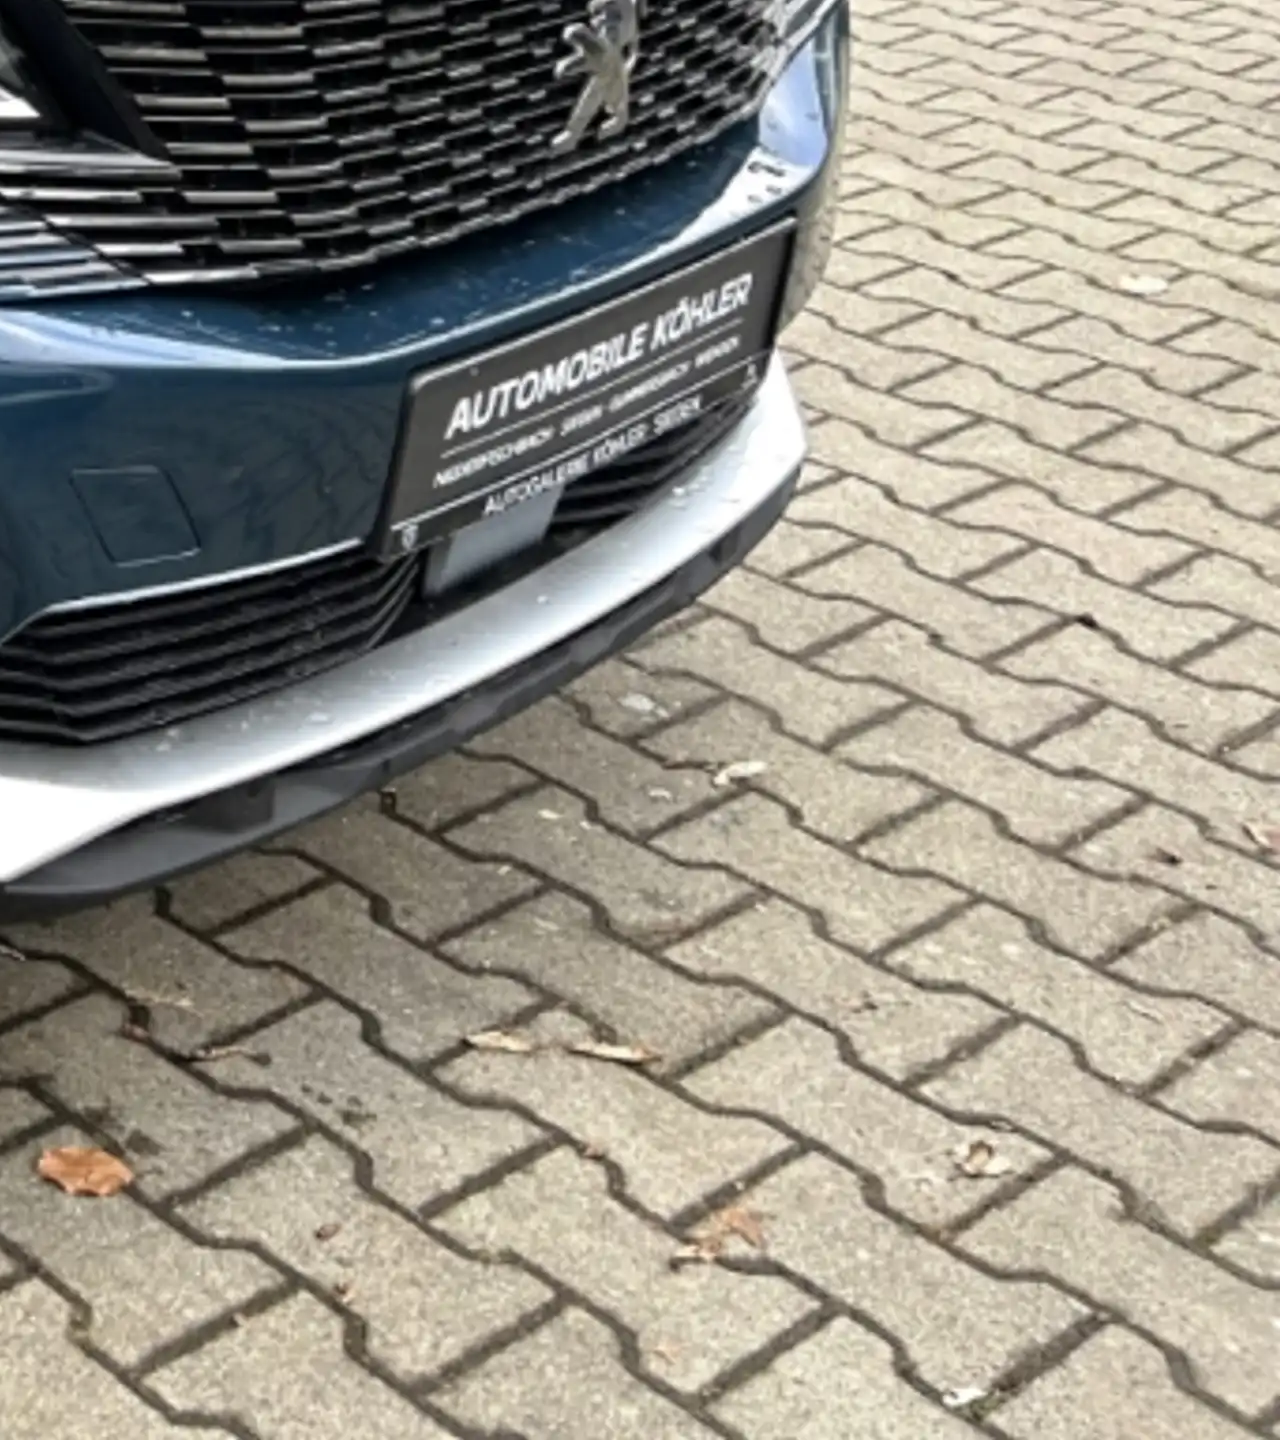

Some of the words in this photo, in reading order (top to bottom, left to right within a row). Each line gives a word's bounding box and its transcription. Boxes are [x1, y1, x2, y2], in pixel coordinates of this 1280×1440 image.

[443, 322, 649, 440] AUTOMOBILE
[650, 273, 753, 352] KÖHLER
[593, 421, 649, 465] KÖHLER
